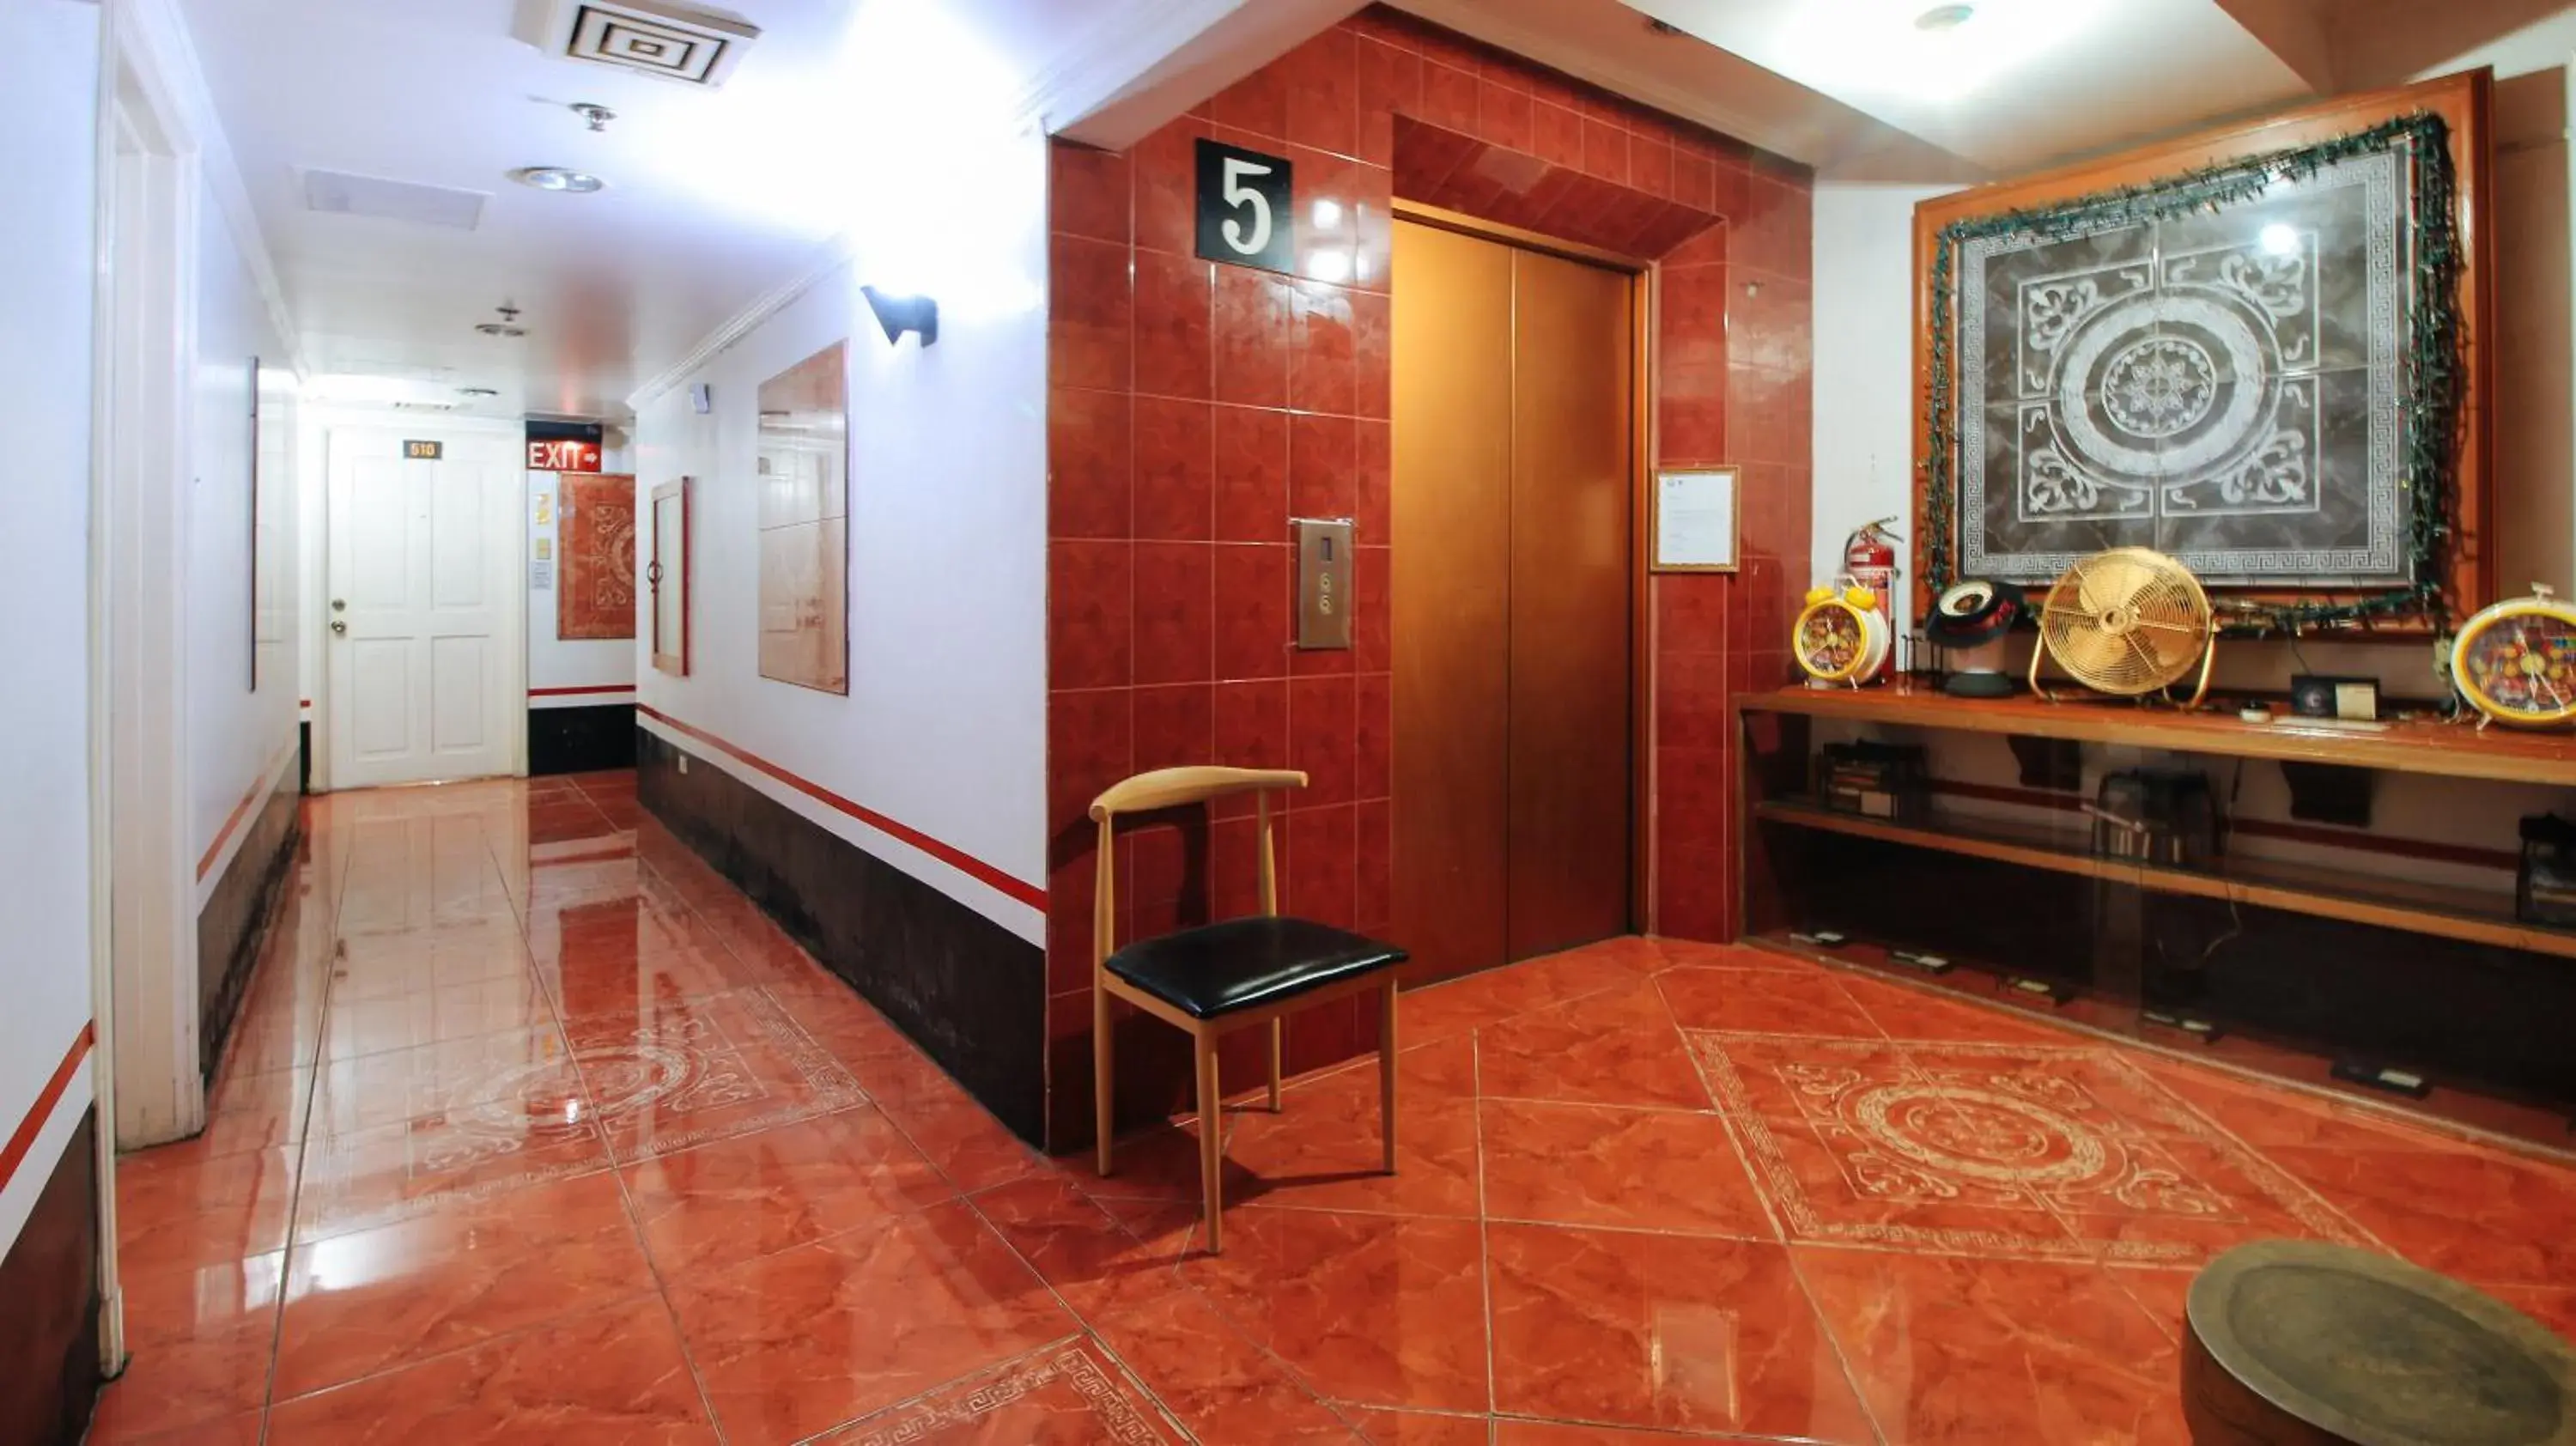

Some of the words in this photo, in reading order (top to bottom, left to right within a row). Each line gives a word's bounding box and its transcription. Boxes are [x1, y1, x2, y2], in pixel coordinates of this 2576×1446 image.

[1222, 157, 1272, 255] 5
[410, 442, 435, 456] 510
[528, 440, 585, 469] EXIT
